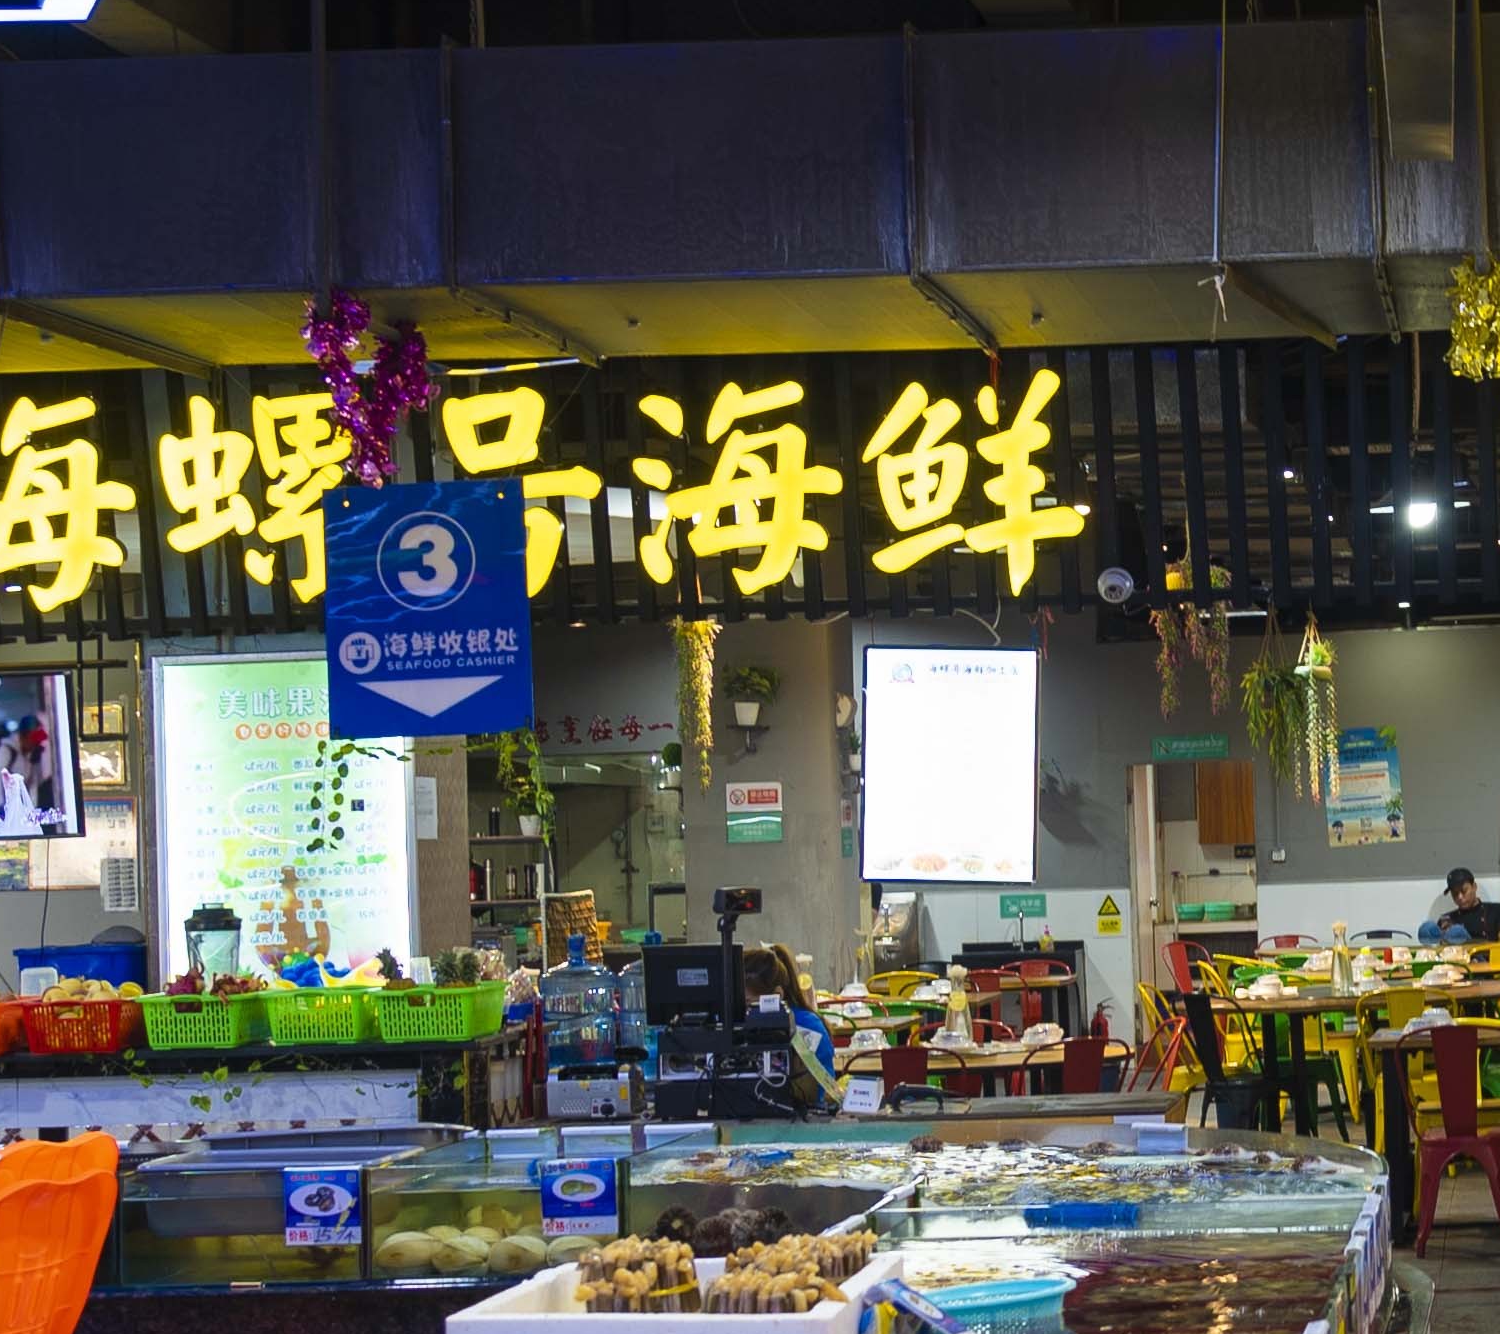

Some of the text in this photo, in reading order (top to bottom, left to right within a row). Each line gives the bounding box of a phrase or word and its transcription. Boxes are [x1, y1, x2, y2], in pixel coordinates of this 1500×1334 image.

[397, 523, 458, 597] 3
[383, 628, 519, 658] 海鲜收银处
[386, 655, 516, 671] SEAFOOD CASHIER
